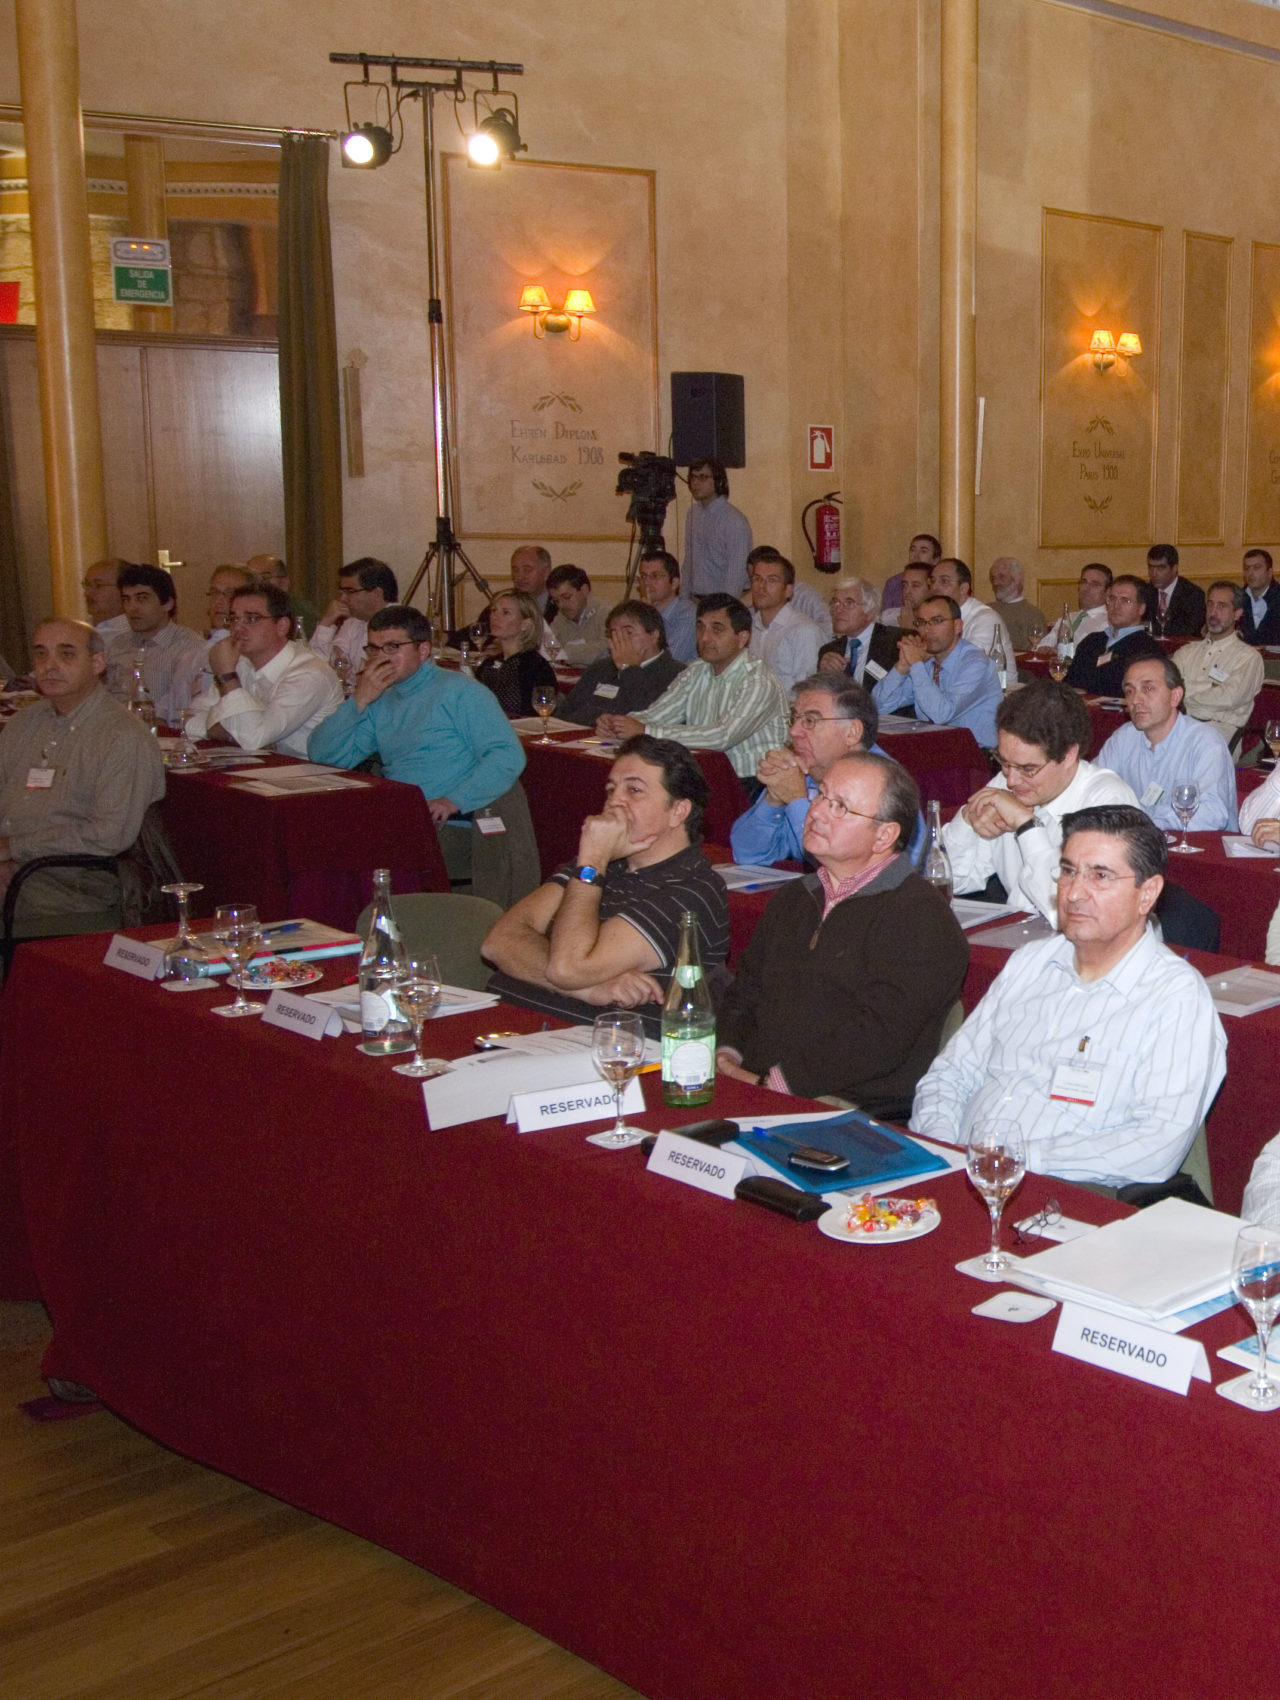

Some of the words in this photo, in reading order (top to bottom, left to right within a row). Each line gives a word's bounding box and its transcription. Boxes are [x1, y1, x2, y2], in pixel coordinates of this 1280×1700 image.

[136, 279, 147, 289] DE
[275, 1003, 317, 1025] RESERVADO
[667, 1150, 726, 1180] RESERVADO
[1080, 1327, 1168, 1368] RESERVADO
